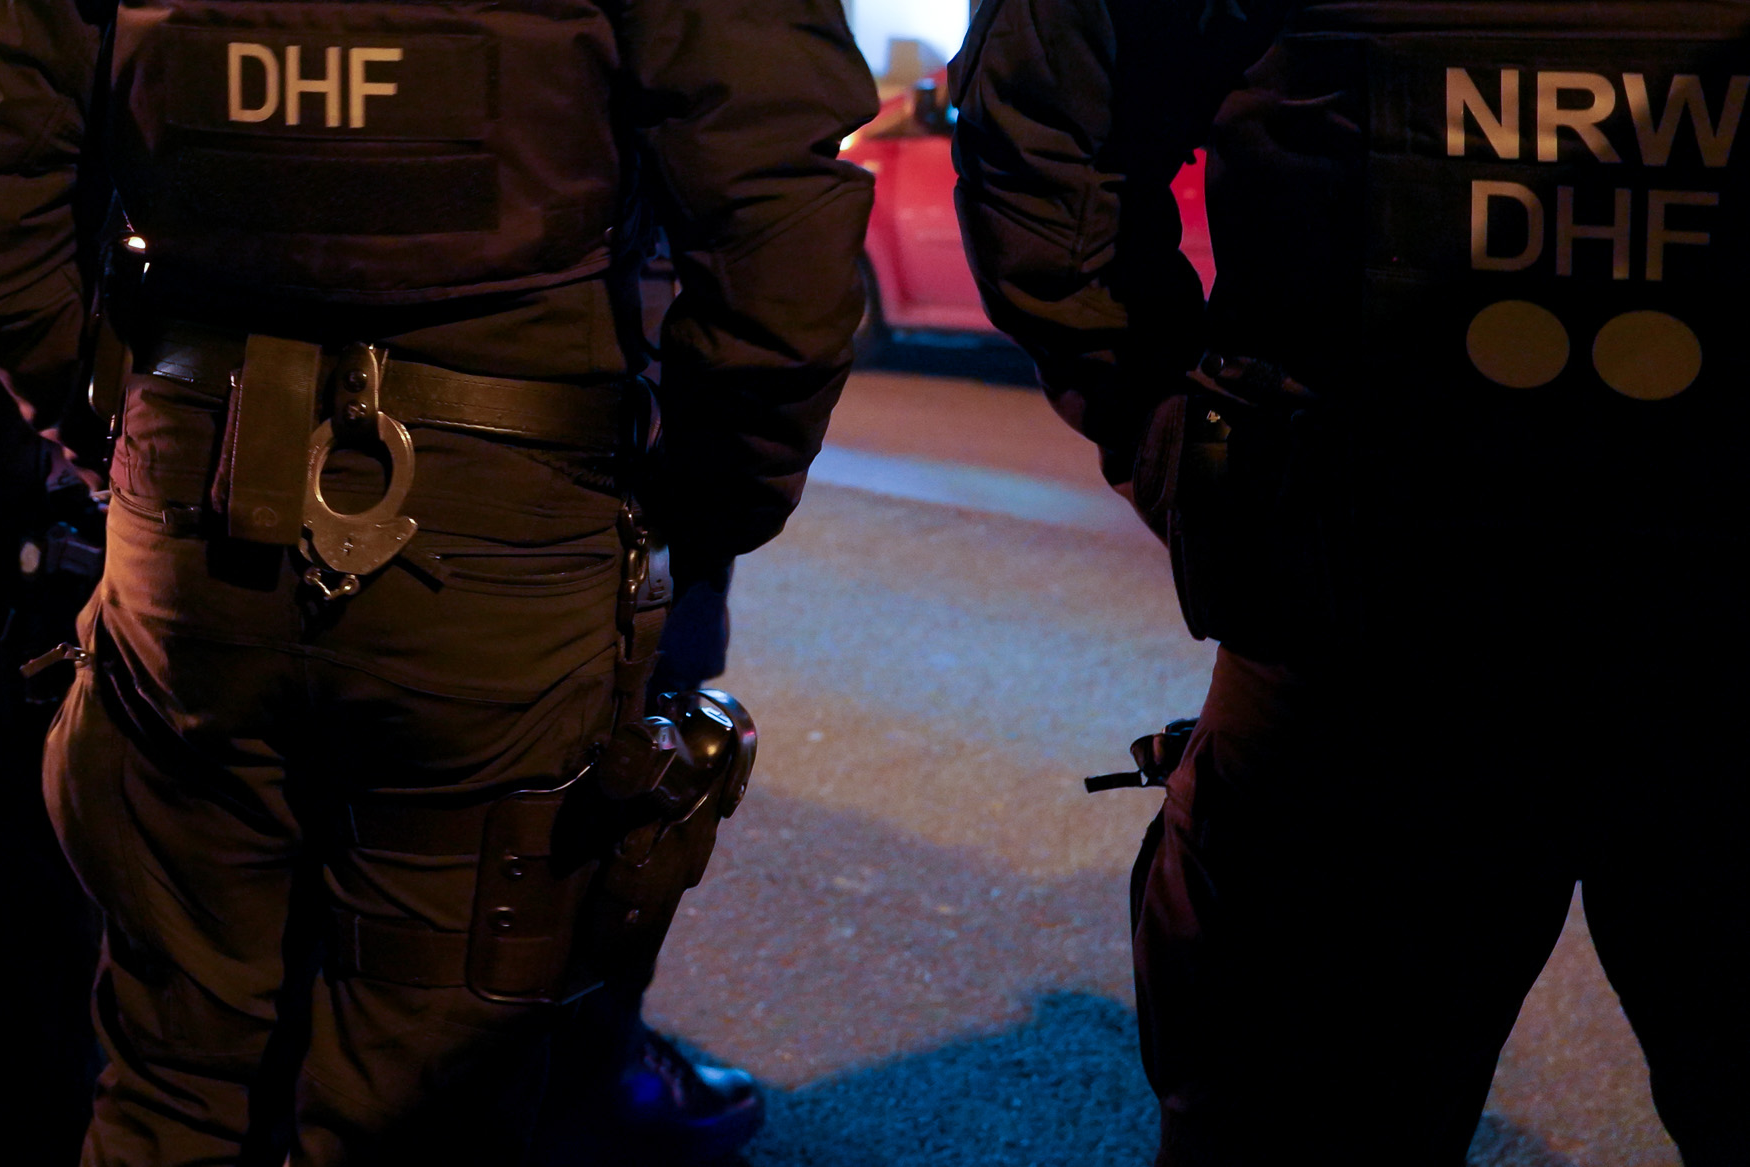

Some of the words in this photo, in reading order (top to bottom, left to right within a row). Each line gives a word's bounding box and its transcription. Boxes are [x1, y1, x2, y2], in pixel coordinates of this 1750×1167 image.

[227, 41, 404, 129] DHF
[1445, 66, 1750, 169] NRW
[1469, 179, 1721, 283] DHF
